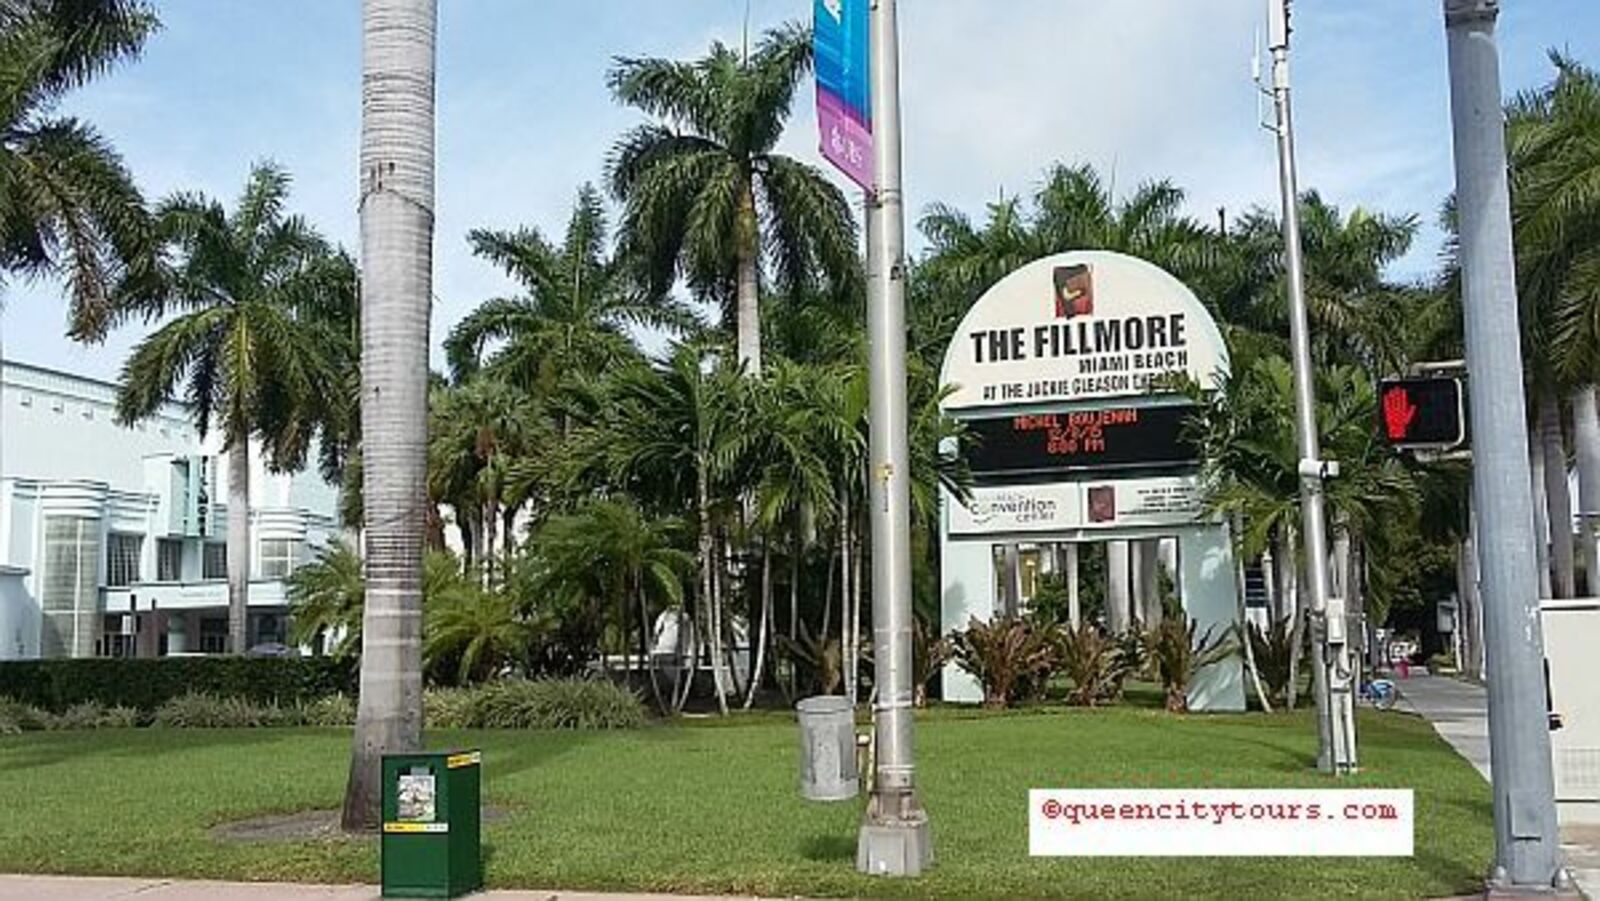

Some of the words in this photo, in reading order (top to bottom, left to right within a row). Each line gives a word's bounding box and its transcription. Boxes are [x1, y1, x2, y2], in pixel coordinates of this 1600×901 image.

[970, 328, 1026, 363] THE
[1034, 313, 1186, 358] FILLMORE
[1079, 355, 1129, 374] MIAMI
[1134, 351, 1188, 369] BEACH
[983, 385, 996, 400] AT
[1002, 383, 1023, 399] THE
[1026, 379, 1069, 398] JACKIE
[1072, 374, 1129, 394] GLEASON
